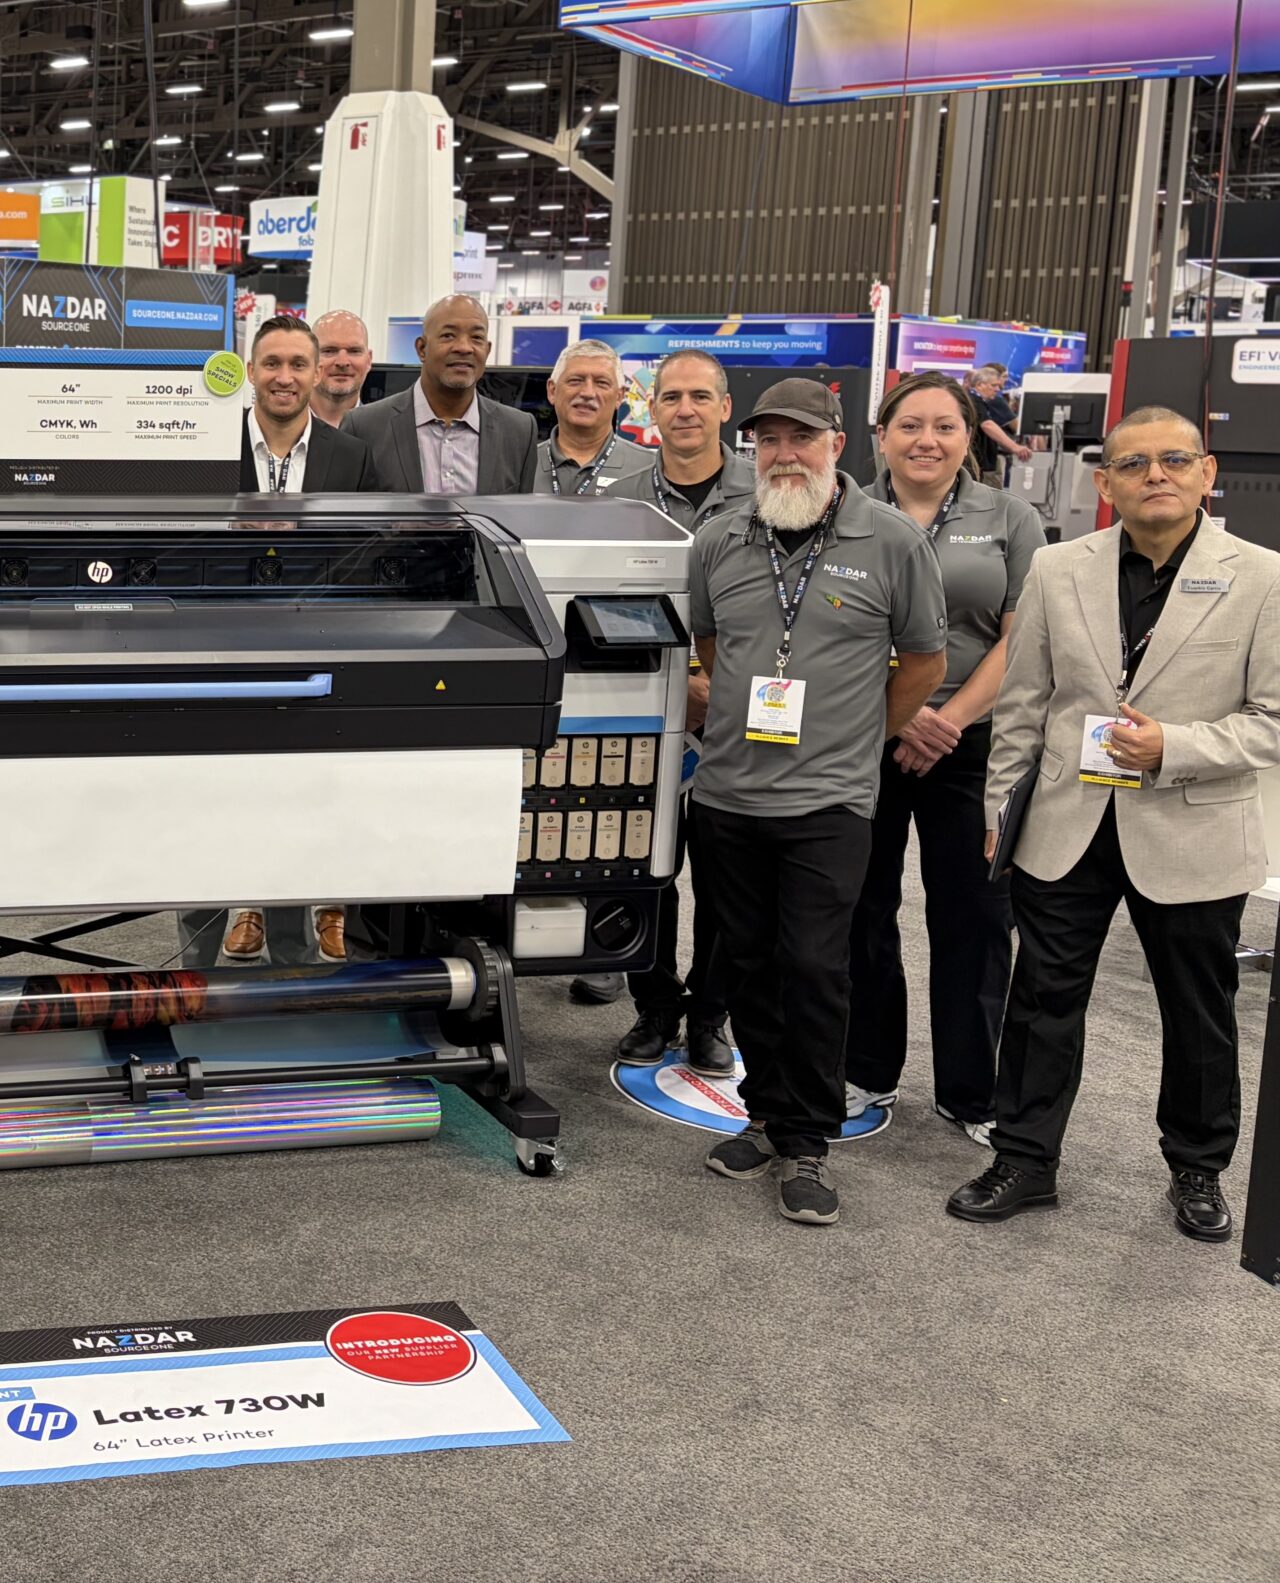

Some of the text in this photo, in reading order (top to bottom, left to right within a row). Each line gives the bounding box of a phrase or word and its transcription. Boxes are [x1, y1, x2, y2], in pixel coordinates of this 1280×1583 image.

[22, 294, 107, 321] NAZDAR
[132, 308, 218, 322] SOURCEONE.NAZDAR.COM
[668, 339, 823, 351] REFRESHMENTS to keep you moving
[1239, 351, 1280, 361] EFI V
[145, 385, 193, 396] 1200 dpi
[40, 419, 97, 430] CMYK, Wh
[136, 420, 197, 432] 334 sqft/hr
[14, 473, 55, 482] NAZDAR
[91, 561, 109, 583] hp
[823, 563, 868, 579] NAZDAR
[72, 1331, 197, 1350] NAZDAR
[335, 1334, 458, 1350] INTRODUCING
[367, 1350, 444, 1361] PARTNERSHIP
[93, 1392, 325, 1426] Latex 730W
[16, 1402, 69, 1442] hp
[136, 1434, 197, 1448] Latex
[203, 1428, 275, 1443] Printer
